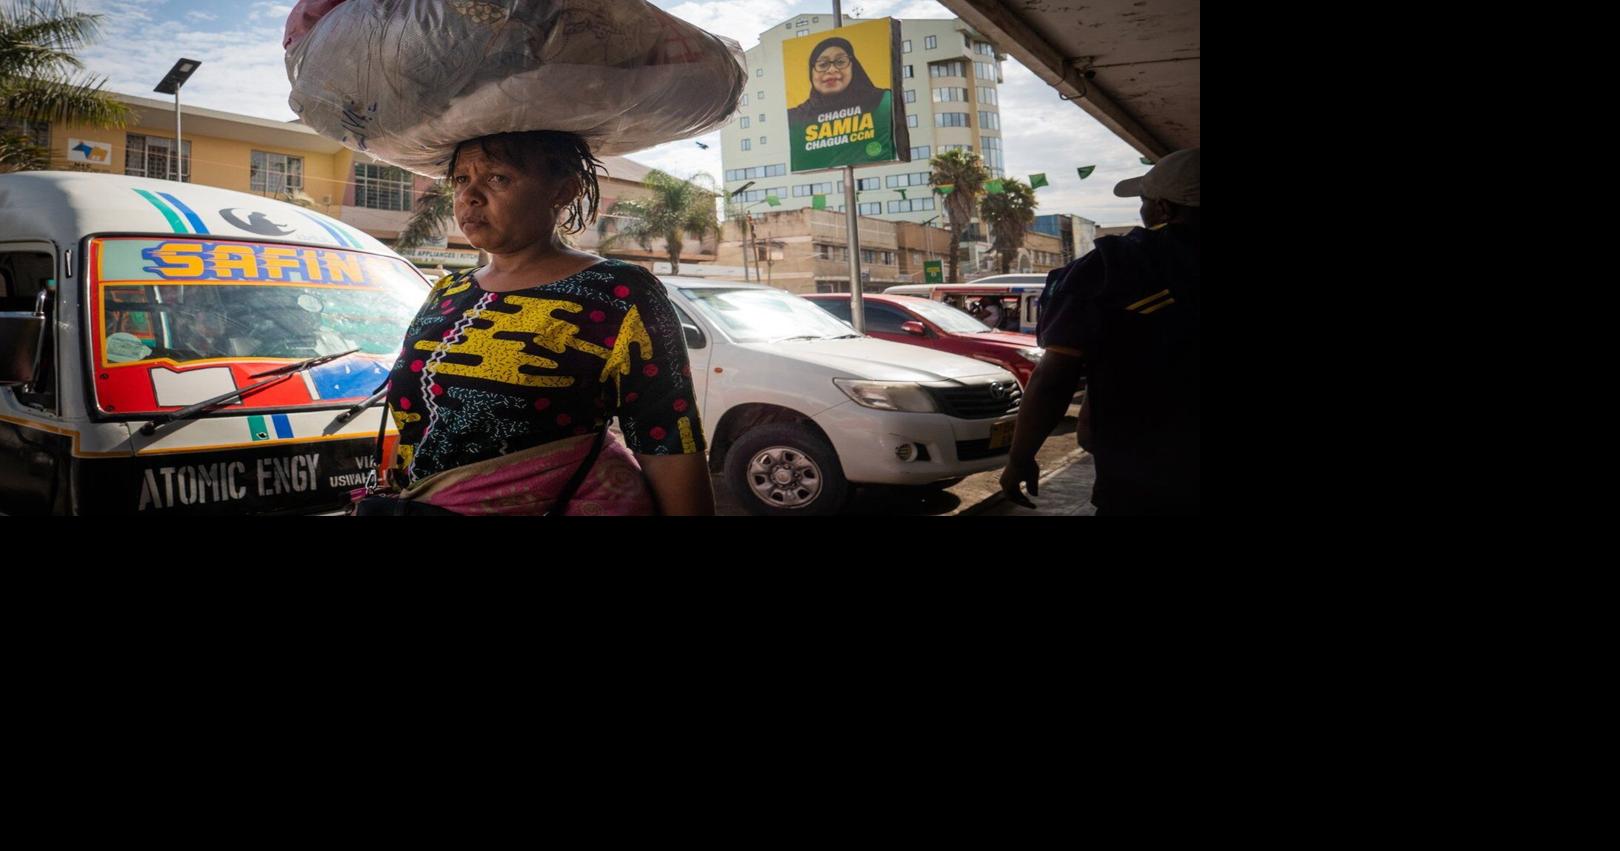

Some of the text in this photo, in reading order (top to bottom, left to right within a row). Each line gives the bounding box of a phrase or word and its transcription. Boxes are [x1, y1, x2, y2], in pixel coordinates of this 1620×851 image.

[805, 112, 874, 141] SAMIA
[818, 106, 861, 122] CHAGUA
[805, 129, 875, 150] CHAGUA CCM
[145, 241, 384, 284] SAFIN
[138, 453, 320, 511] ATOMIC ENGY
